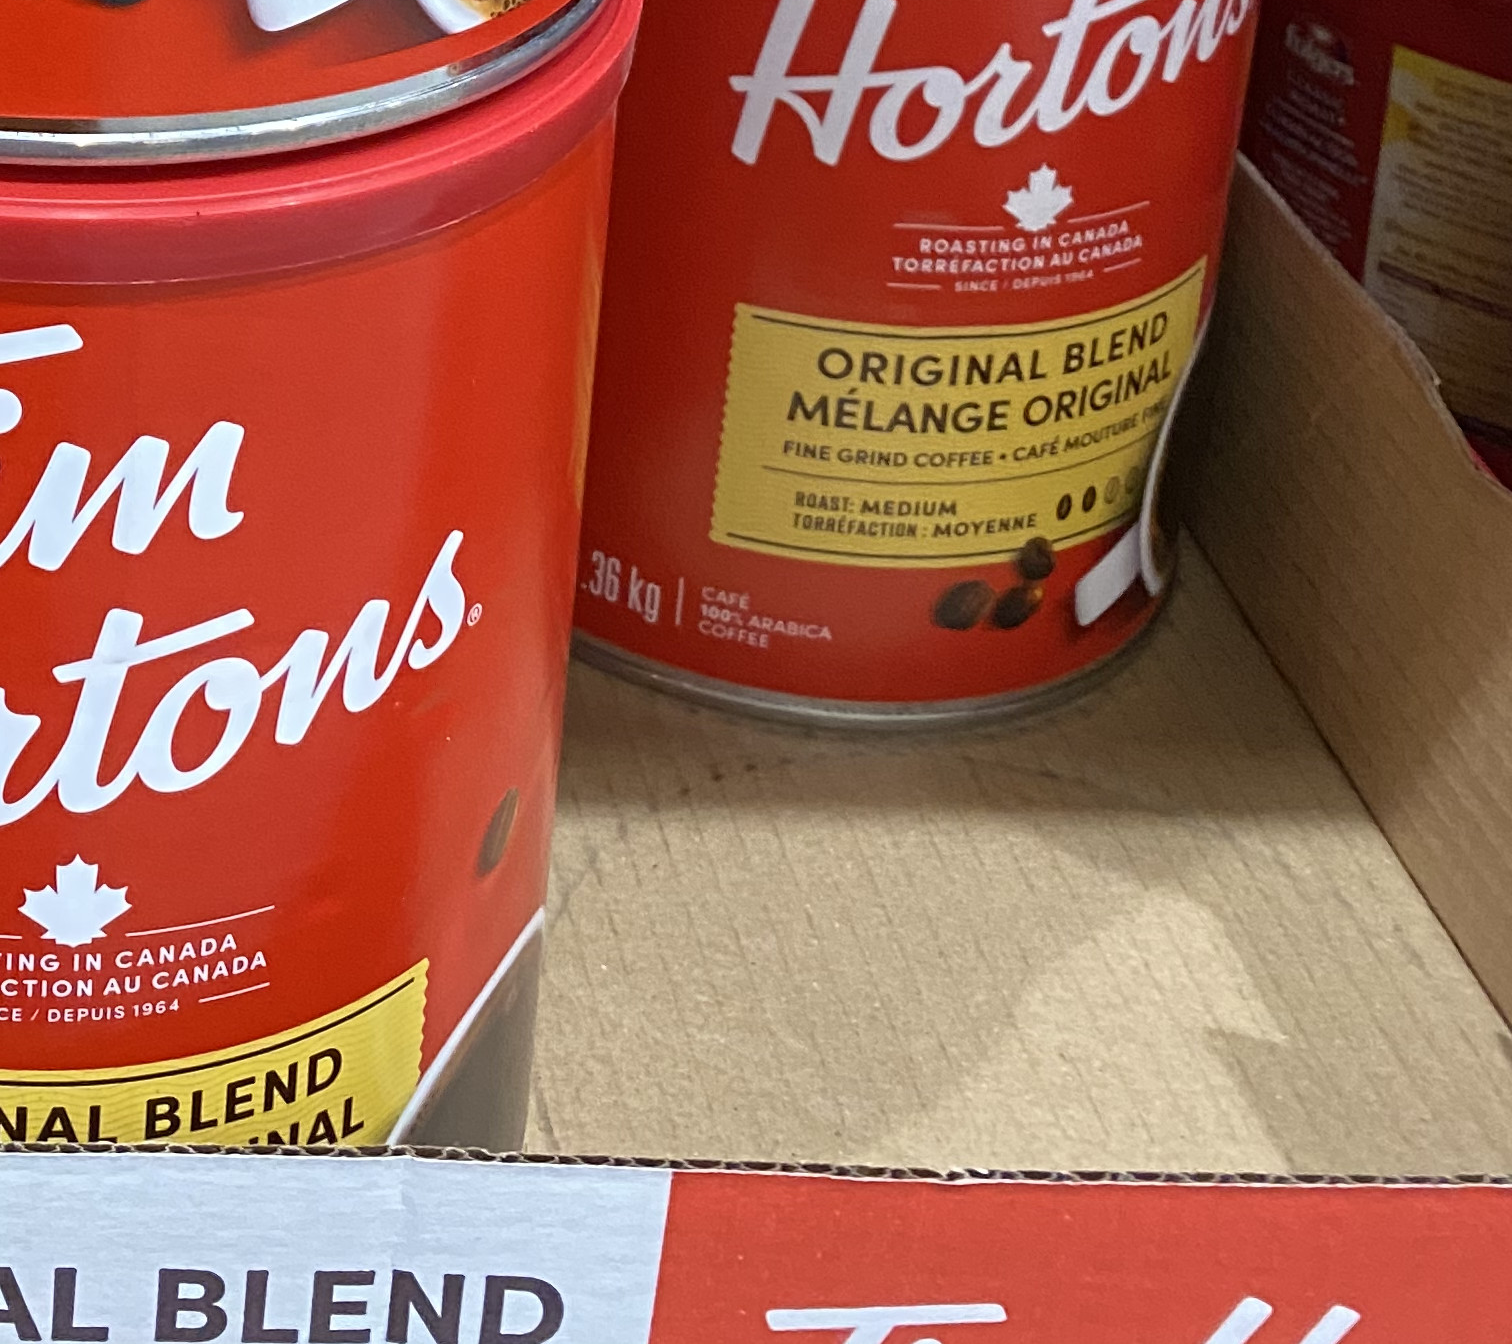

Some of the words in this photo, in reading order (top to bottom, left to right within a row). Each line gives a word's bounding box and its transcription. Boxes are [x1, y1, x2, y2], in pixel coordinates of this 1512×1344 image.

[919, 237, 1026, 253] ROASTING
[1032, 236, 1052, 250] IN
[1058, 220, 1129, 247] CANADA
[1049, 252, 1074, 266] AU
[1078, 235, 1143, 262] CANADA
[817, 347, 1047, 387] ORIGINAL
[1063, 311, 1168, 375] BLEND
[786, 387, 1011, 435] MÉLANGE
[1023, 350, 1172, 427] ORIGINAL
[782, 440, 832, 462] FINE
[837, 447, 908, 468] GRIND
[913, 450, 994, 468] COFFEE
[1013, 435, 1059, 462] CAFÉ
[860, 498, 958, 517] MEDIUM
[932, 513, 1037, 538] MOYENNE
[627, 566, 661, 624] kg
[701, 586, 751, 611] CAFÉ
[698, 619, 770, 649] COFFEE
[748, 615, 833, 641] ARABICA
[73, 952, 101, 972] IN
[114, 932, 238, 970] CANADA
[103, 975, 141, 996] AU
[151, 950, 268, 990] CANADA
[47, 1004, 125, 1023] DEPUIS
[132, 998, 181, 1018] 1964
[144, 1047, 343, 1140] BLEND
[154, 1267, 565, 1344] BLEND
